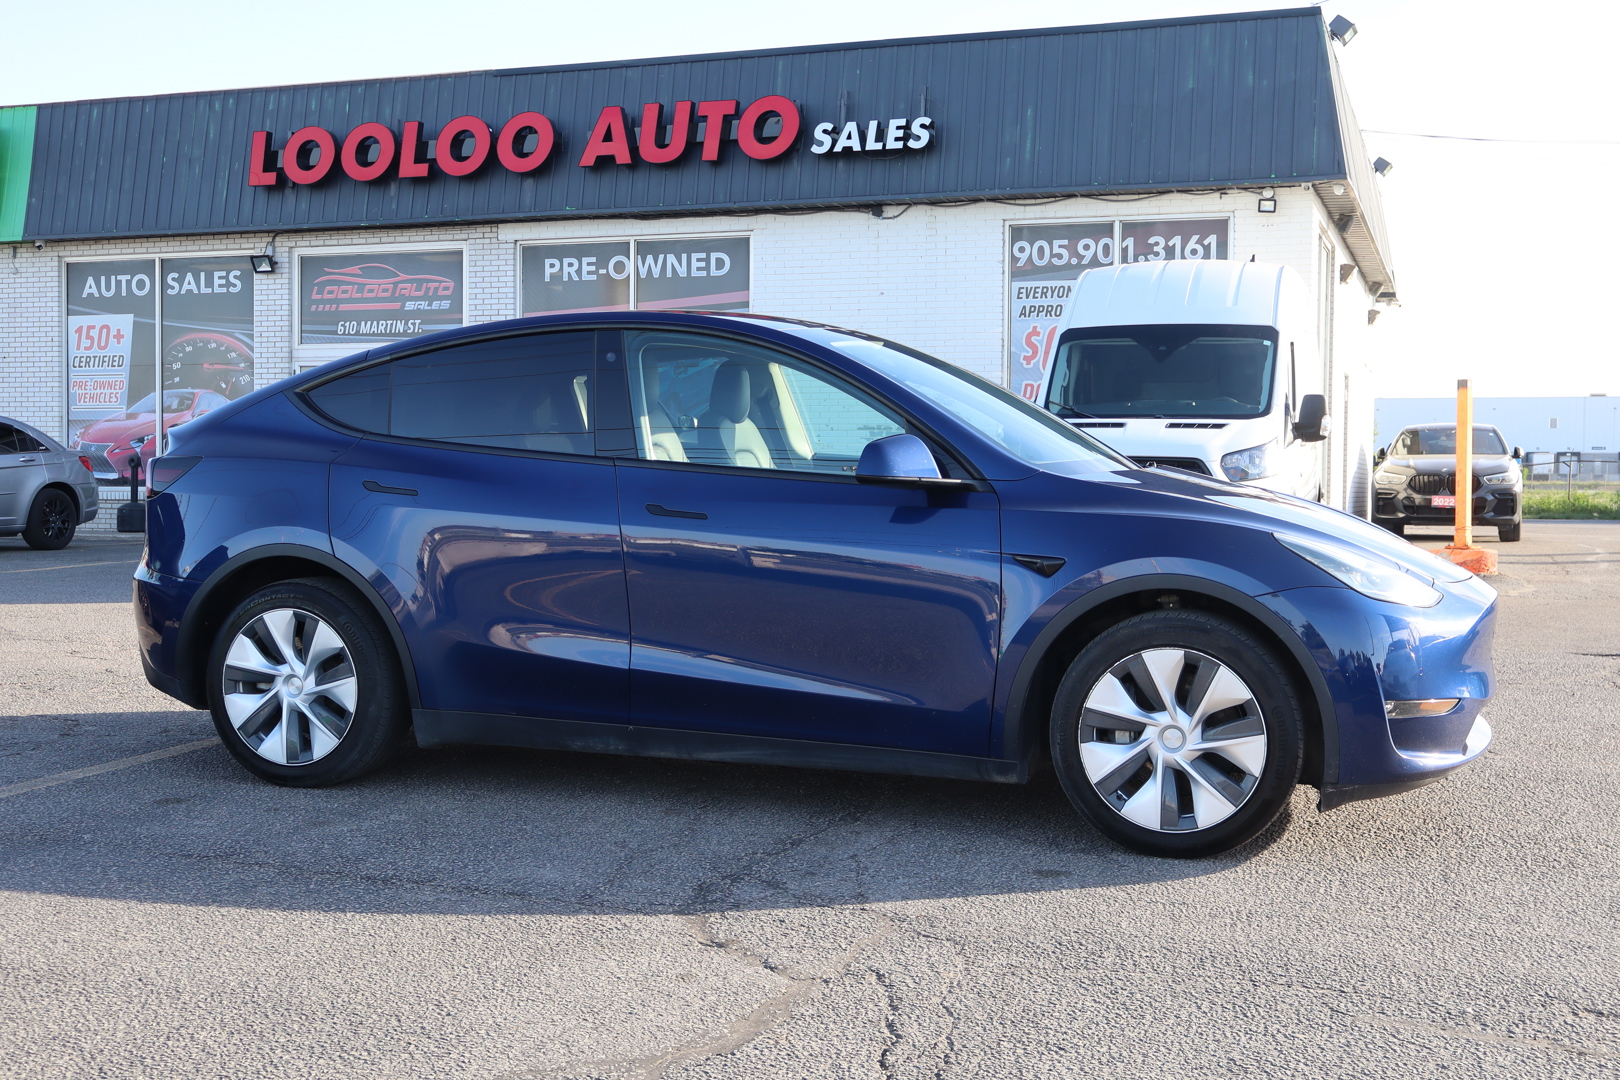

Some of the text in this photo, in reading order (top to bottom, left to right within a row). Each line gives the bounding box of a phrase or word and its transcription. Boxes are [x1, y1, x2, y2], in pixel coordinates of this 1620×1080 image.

[248, 94, 933, 188] LOOLOO AUTO SALES
[1012, 234, 1218, 267] 905.901.3161
[544, 252, 731, 282] PRE-OWNED
[82, 270, 242, 298] AUTO SALES
[311, 282, 455, 299] LOOLOO AUTO
[1016, 285, 1072, 300] EVERYON
[403, 300, 452, 311] SALES
[1018, 304, 1065, 319] APPRO
[337, 319, 423, 335] 610 MARTIN ST.
[74, 324, 125, 352] 150+
[72, 354, 125, 369] CERTIFIED
[172, 361, 181, 370] 50
[71, 379, 125, 391] PRE-OWNED
[77, 391, 119, 404] VEHICLES
[1433, 497, 1455, 506] 2022
